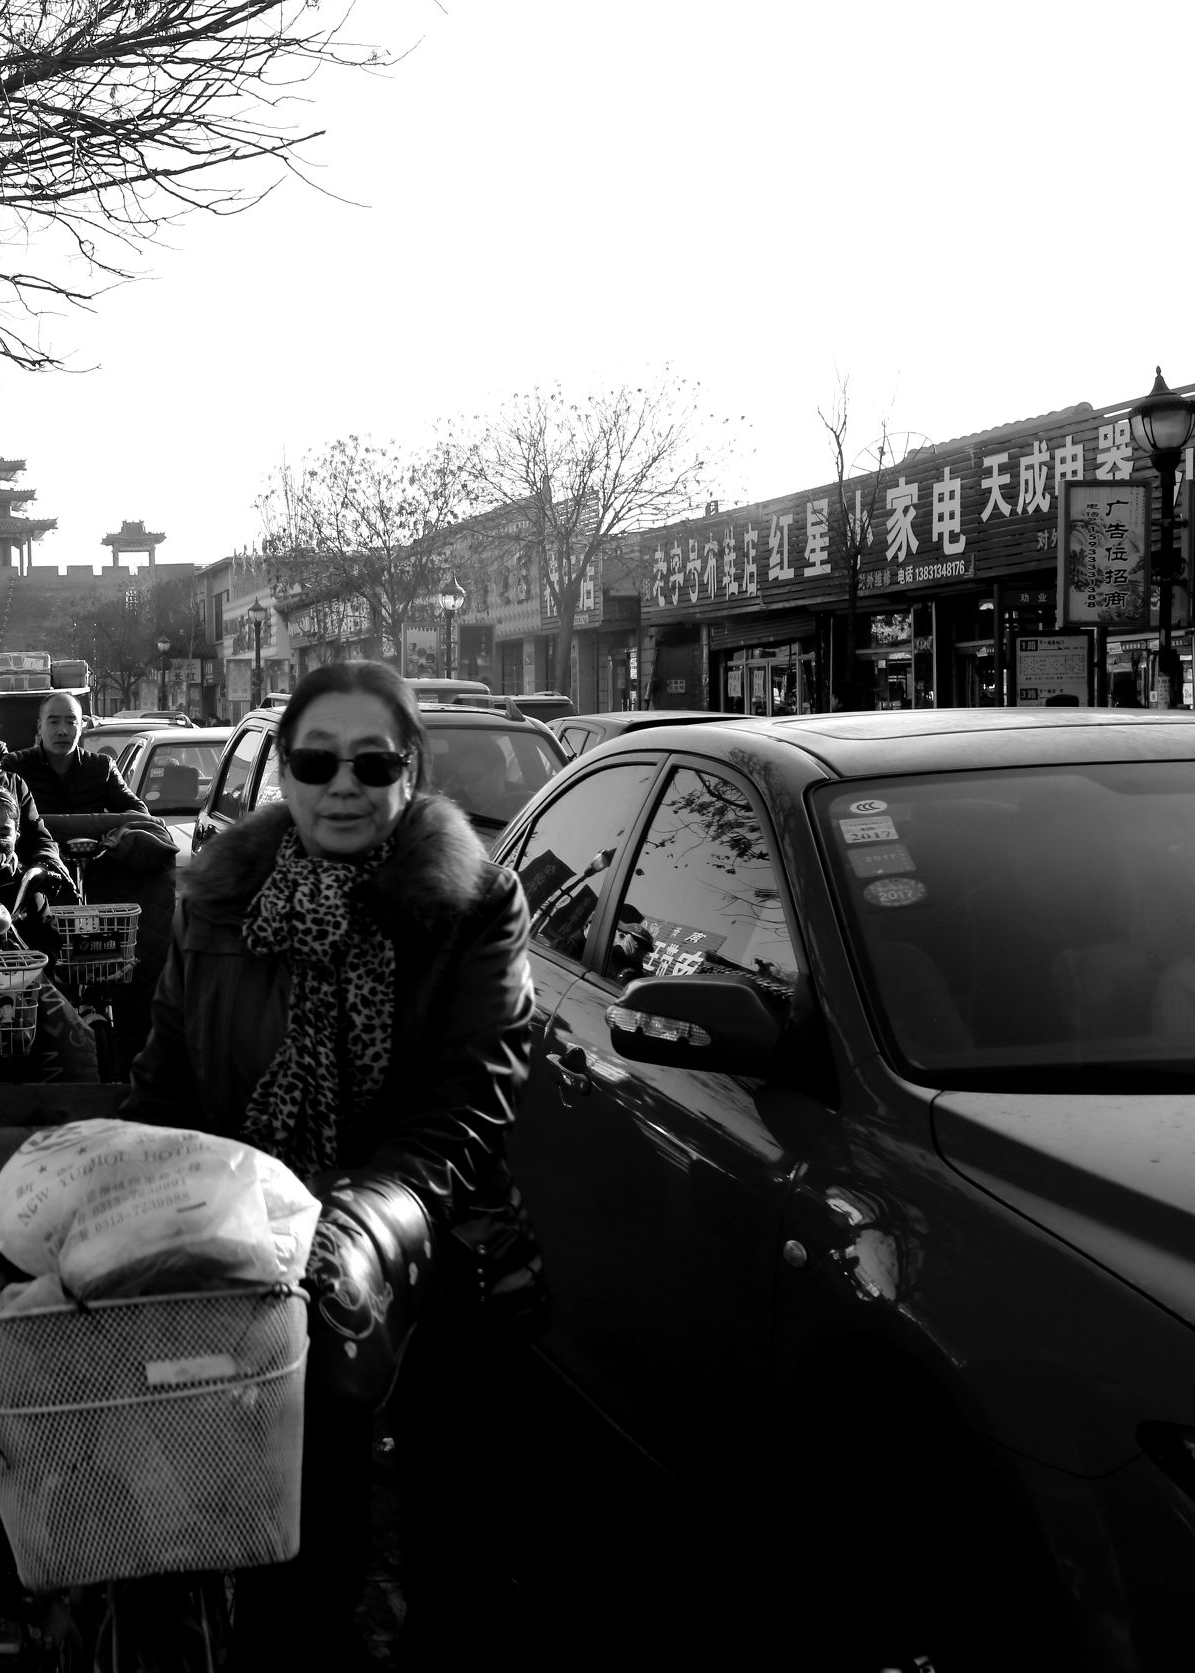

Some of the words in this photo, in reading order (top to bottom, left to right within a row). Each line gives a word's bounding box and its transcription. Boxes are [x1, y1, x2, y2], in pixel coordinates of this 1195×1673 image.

[981, 421, 1134, 523] 天成电器
[653, 522, 759, 607] 老字号布鞋店
[897, 565, 913, 584] 电话
[915, 560, 965, 581] 13831348176
[1104, 499, 1129, 608] 广告位招商
[851, 831, 891, 841] 2017
[878, 889, 913, 902] 2017
[17, 1186, 50, 1227] NEW
